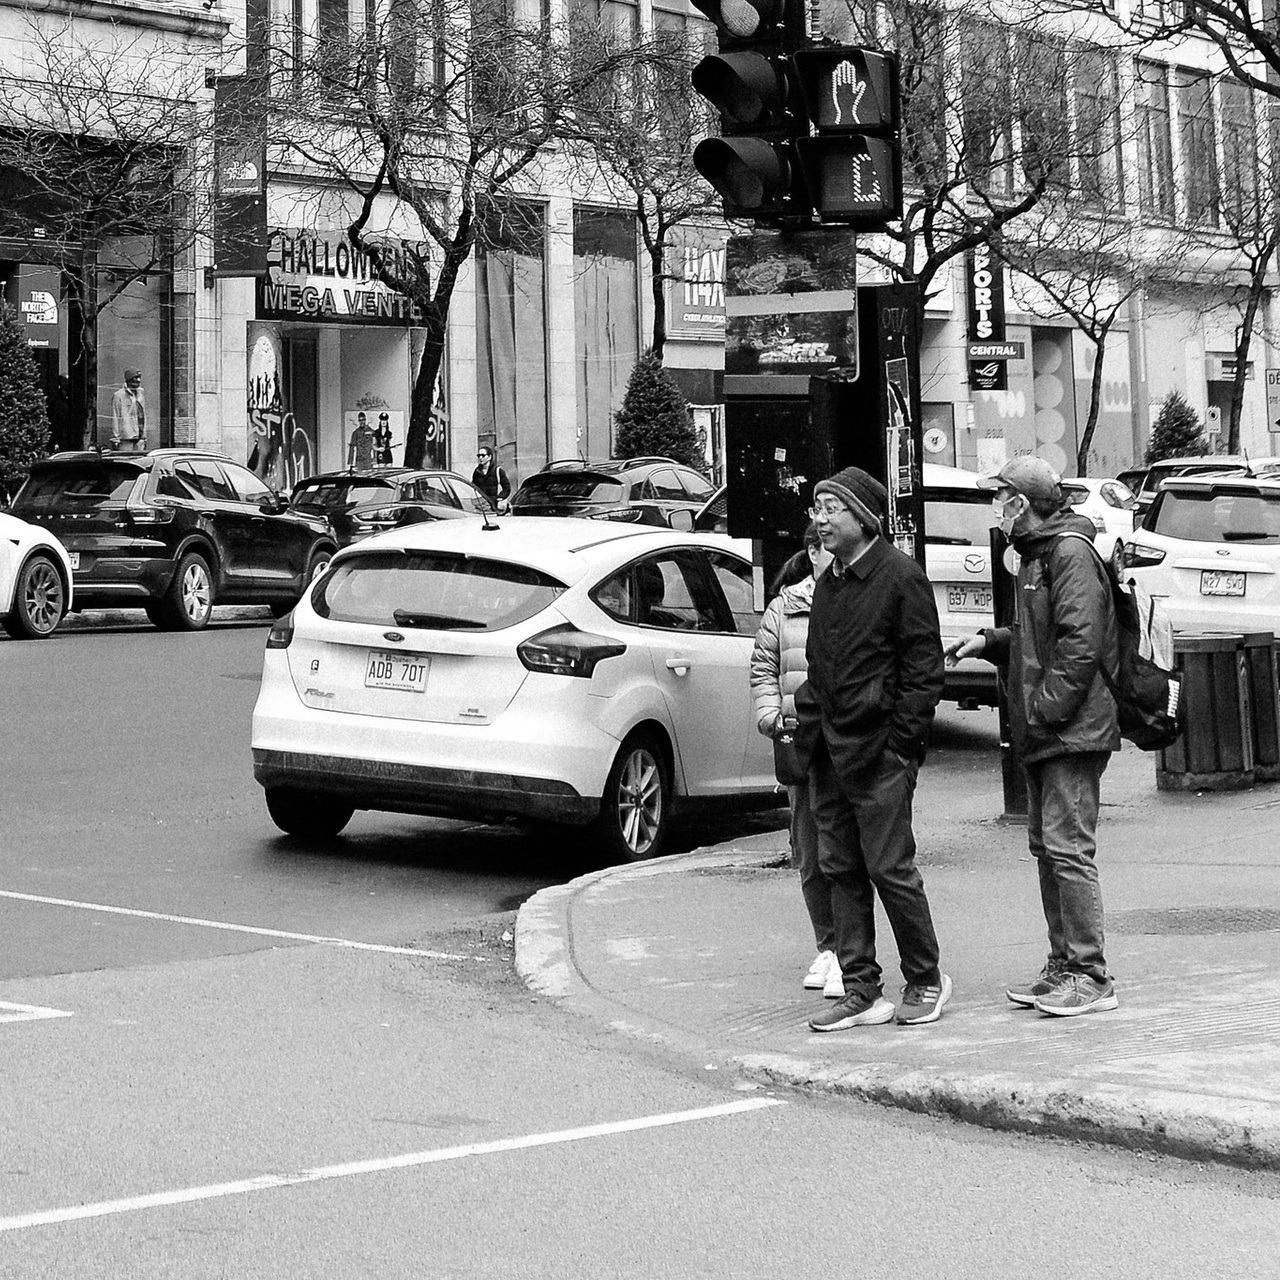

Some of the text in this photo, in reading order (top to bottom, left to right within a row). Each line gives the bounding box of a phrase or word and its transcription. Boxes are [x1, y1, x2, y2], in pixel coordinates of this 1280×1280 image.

[21, 302, 46, 313] NORTH
[263, 284, 423, 320] MEGA VENTE
[969, 345, 1018, 356] CENTRAL
[368, 660, 393, 680] ADB
